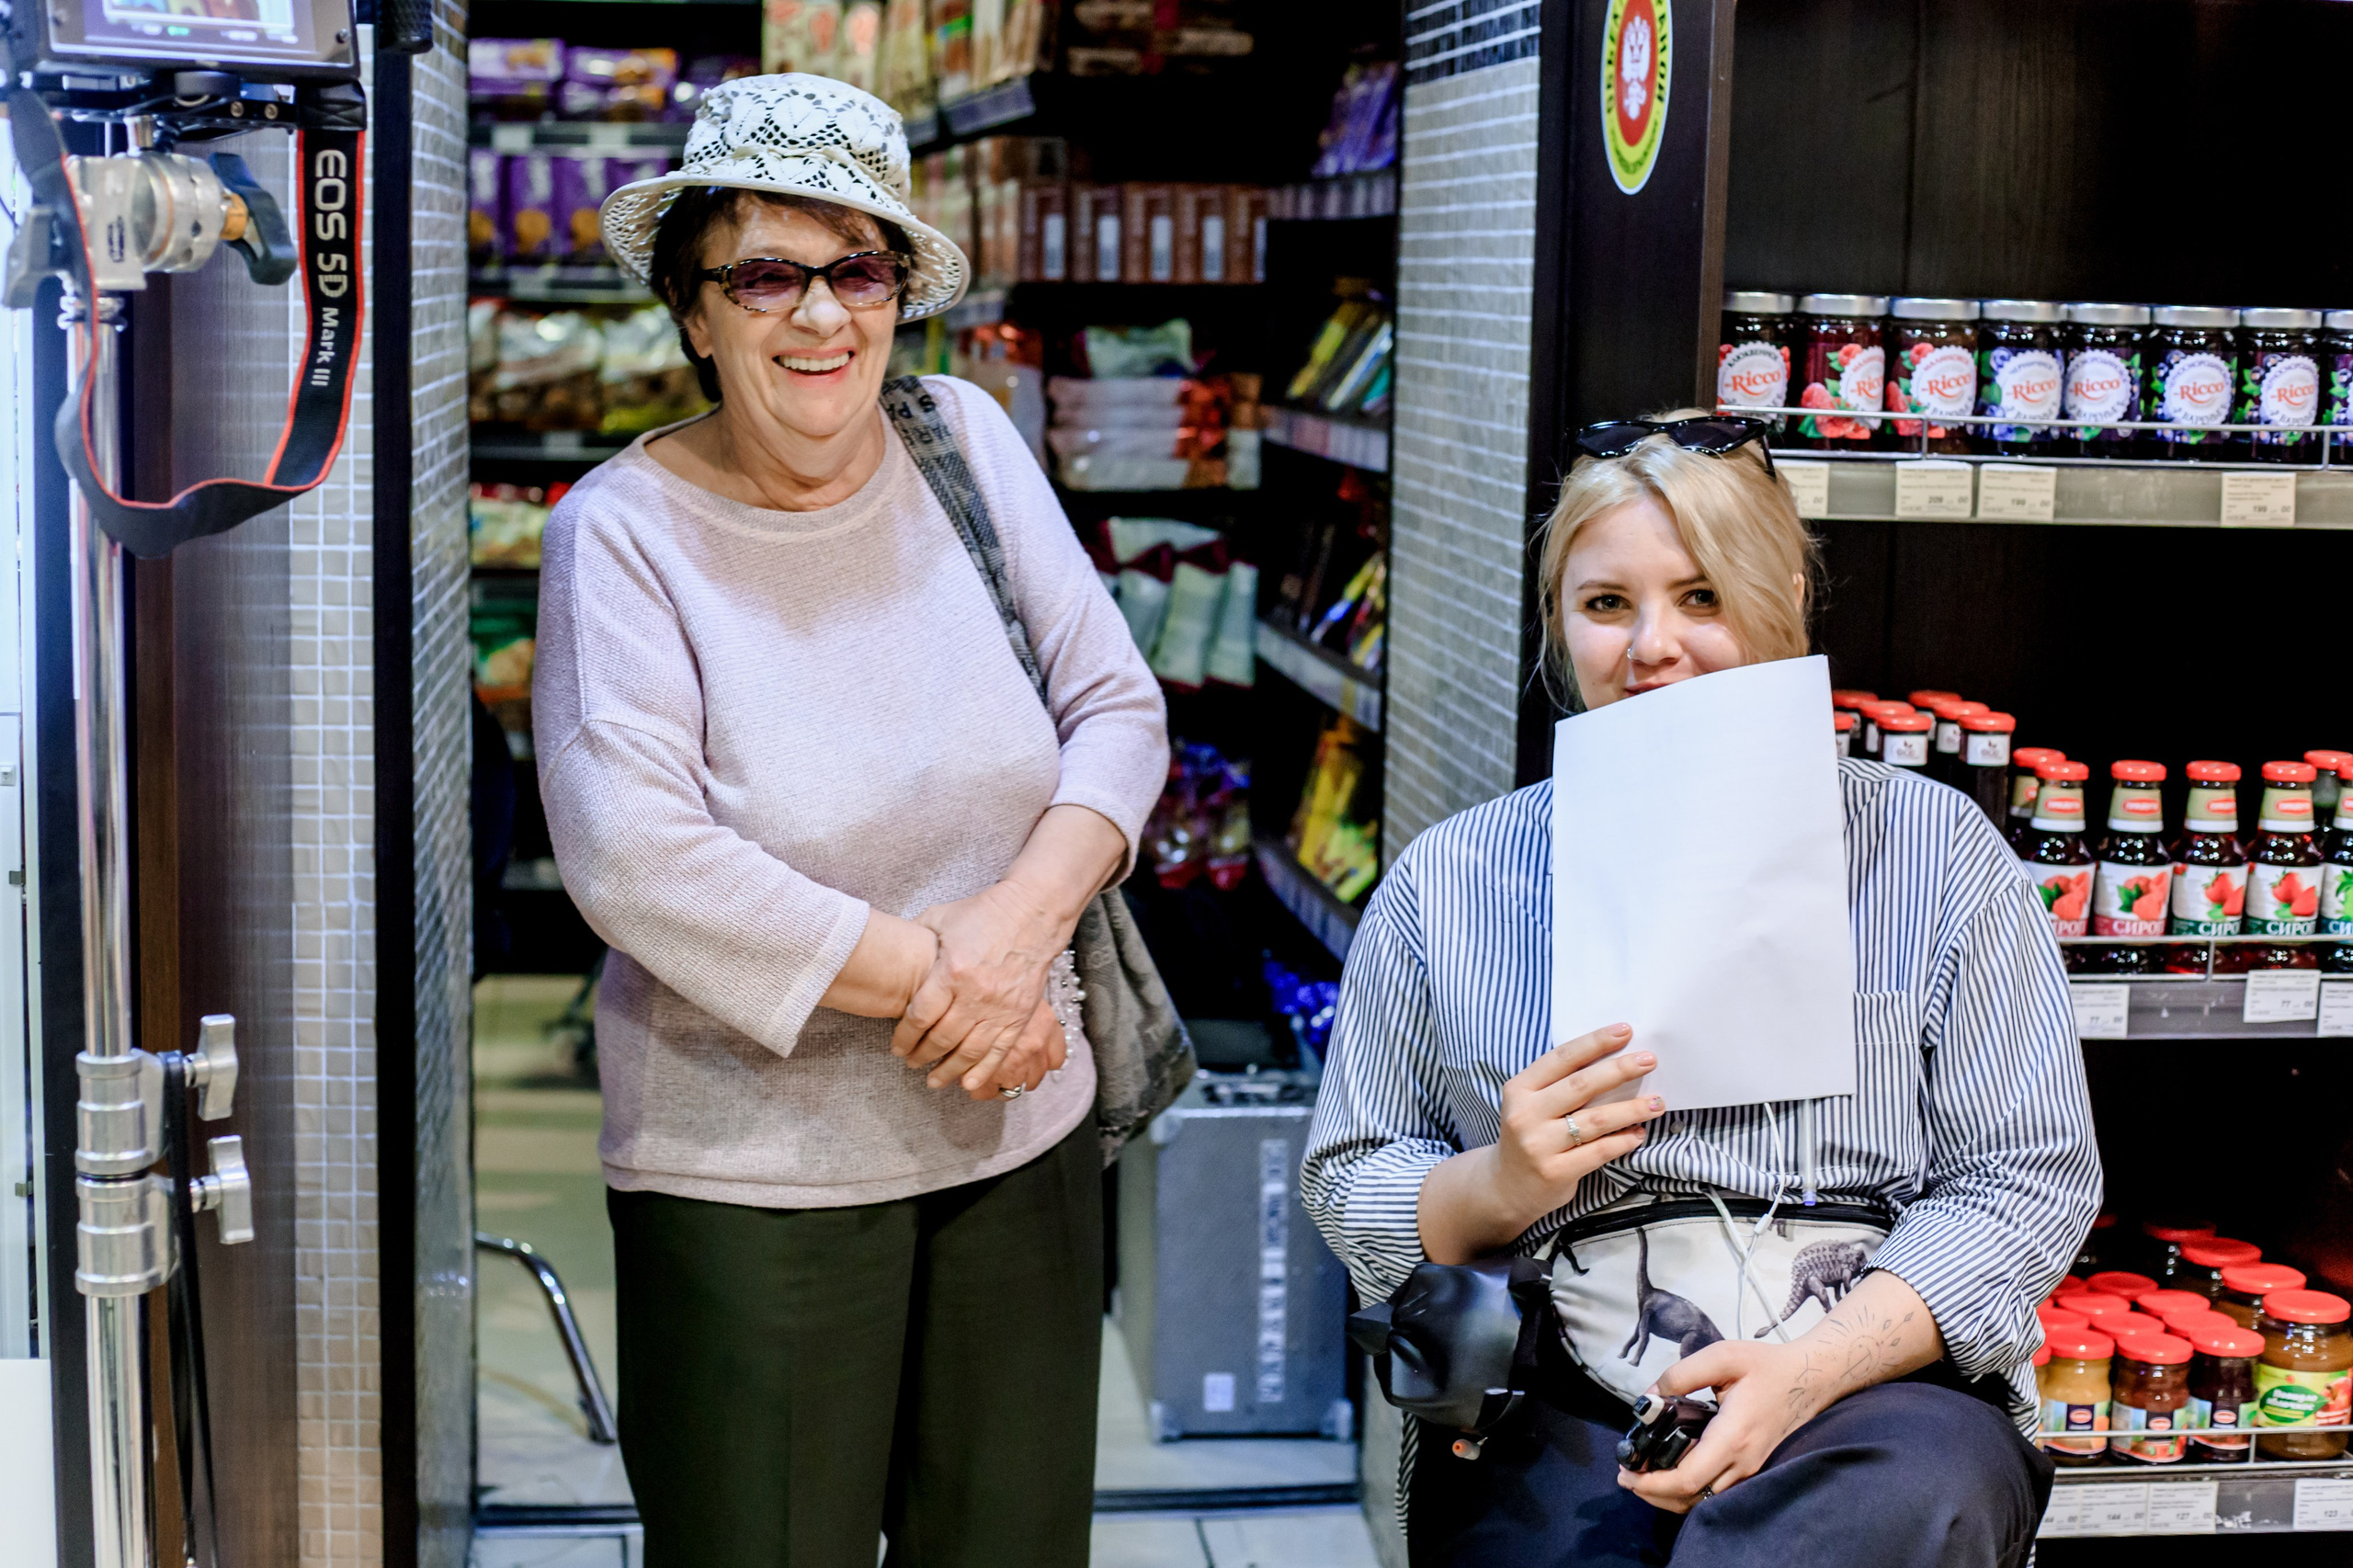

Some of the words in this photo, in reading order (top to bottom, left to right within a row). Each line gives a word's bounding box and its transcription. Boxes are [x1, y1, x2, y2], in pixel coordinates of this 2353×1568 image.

[314, 149, 347, 241] EOS
[317, 253, 348, 298] 5D
[316, 307, 339, 364] Mark
[311, 368, 331, 386] III
[1732, 370, 1781, 396] Ricco
[1927, 374, 1972, 399] Ricco
[2012, 379, 2057, 403] Ricco
[2075, 379, 2121, 401] Ricco
[2179, 381, 2225, 404] Ricco
[2277, 384, 2315, 406] Ricco
[2198, 921, 2241, 936] СИРО
